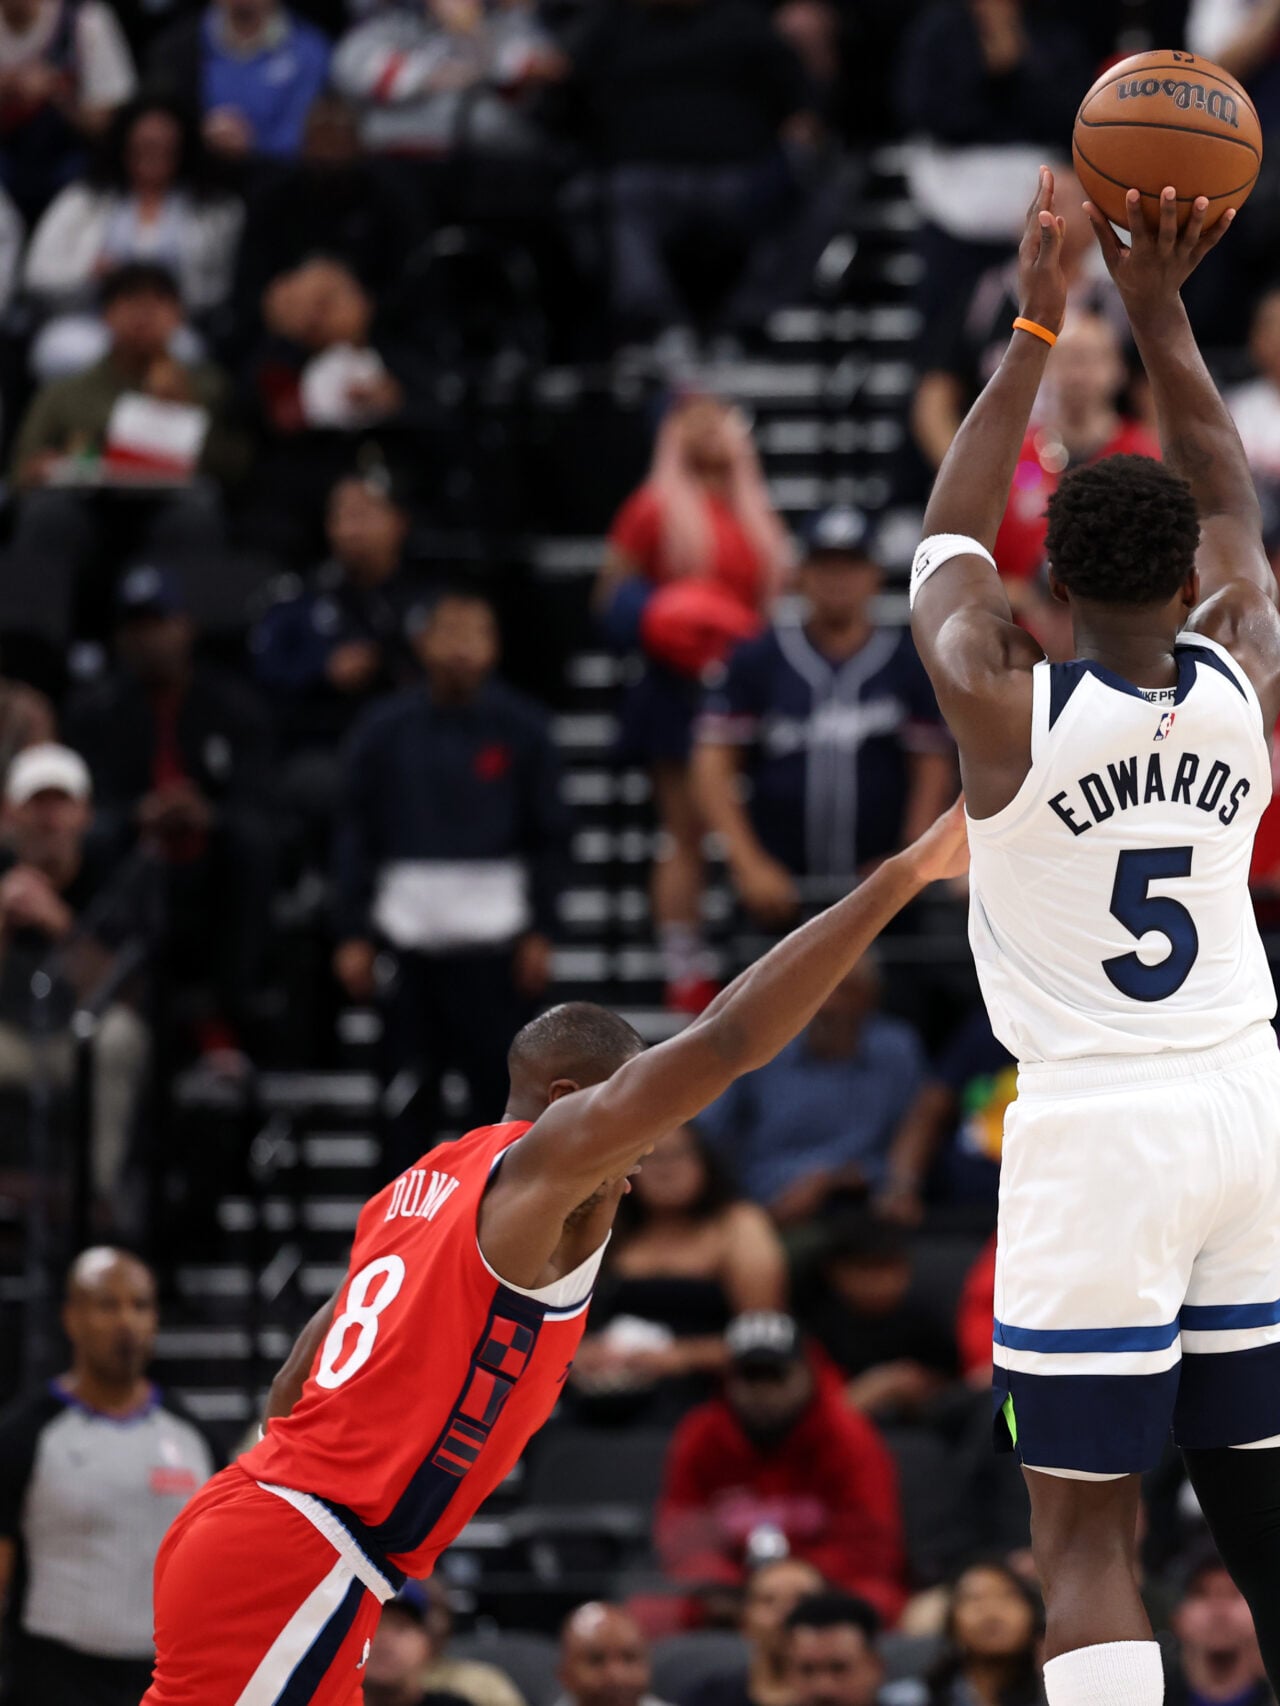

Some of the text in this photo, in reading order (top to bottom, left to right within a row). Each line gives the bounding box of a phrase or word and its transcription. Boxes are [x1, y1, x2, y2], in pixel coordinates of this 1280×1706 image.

[1116, 78, 1239, 128] Wilson
[1047, 752, 1251, 837] EDWARDS
[1101, 846, 1199, 1002] 5
[384, 1169, 460, 1222] DUNN
[315, 1254, 406, 1389] 8
